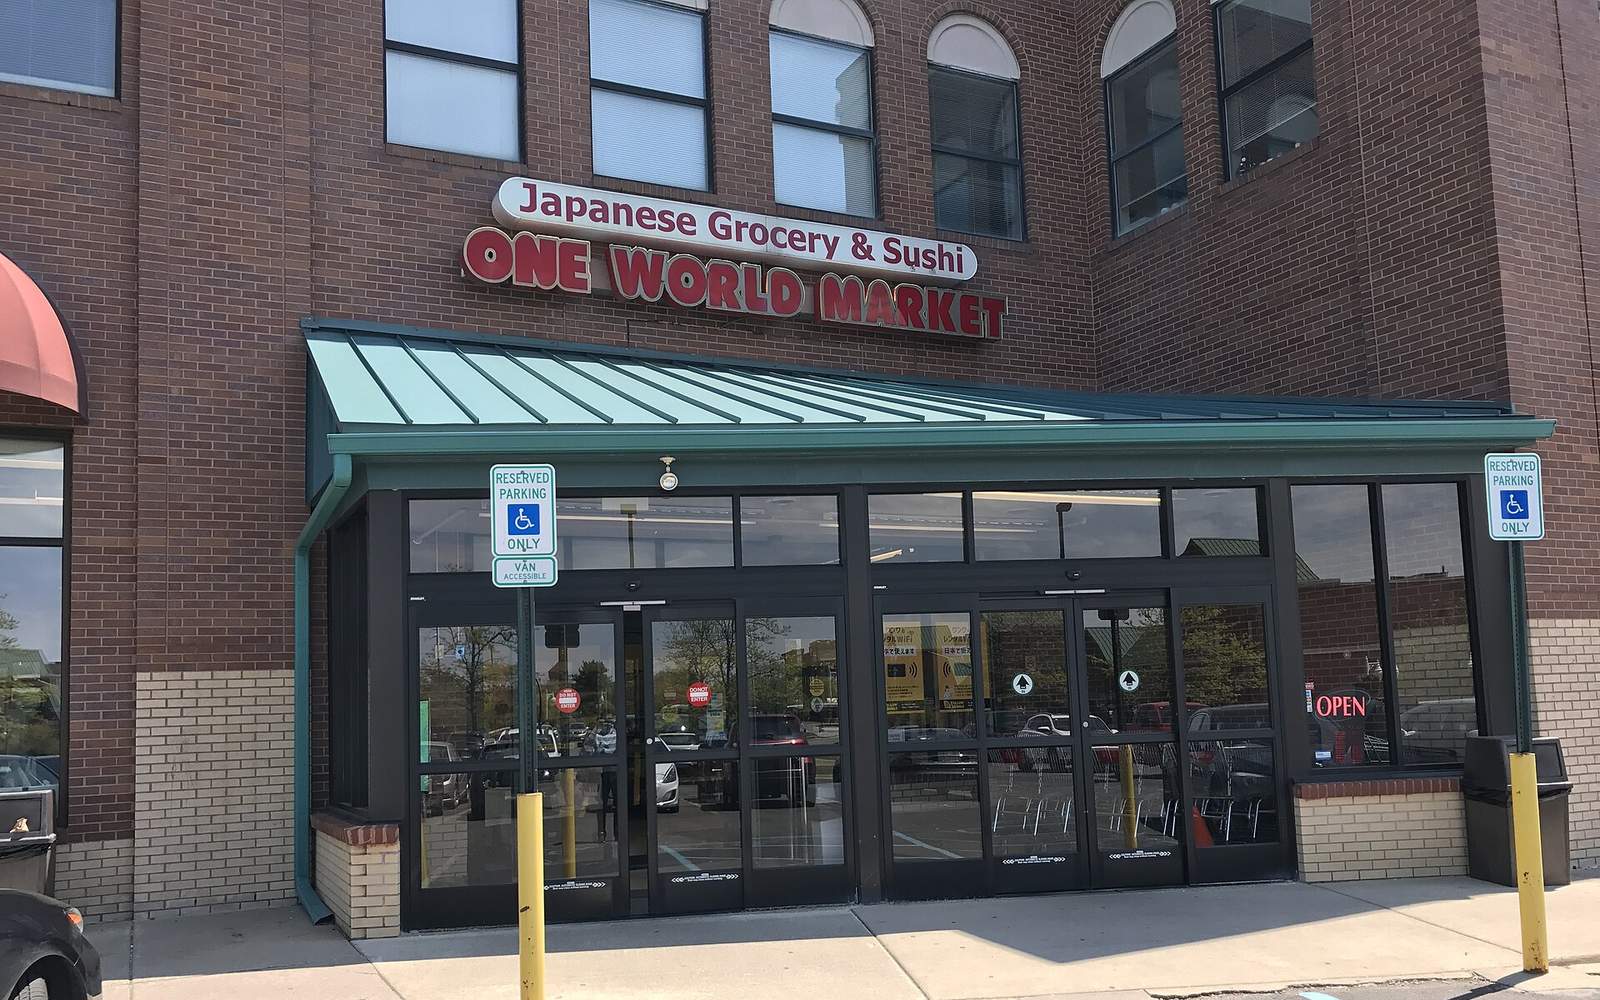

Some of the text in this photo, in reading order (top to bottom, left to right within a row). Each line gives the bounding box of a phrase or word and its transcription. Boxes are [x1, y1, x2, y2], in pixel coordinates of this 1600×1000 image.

[519, 182, 964, 274] Japanese Grocery & Sushi
[463, 226, 1009, 340] ONE WORLD MARKET
[1489, 461, 1536, 471] RESERVED
[496, 472, 549, 484] RESERVED
[1493, 475, 1533, 486] PARKING
[500, 488, 547, 499] PARKING
[1502, 522, 1530, 533] ONLY
[508, 538, 541, 550] ONLY
[515, 563, 536, 572] VAN
[503, 572, 547, 580] ACCESSIBLE
[1316, 695, 1366, 717] OPEN
